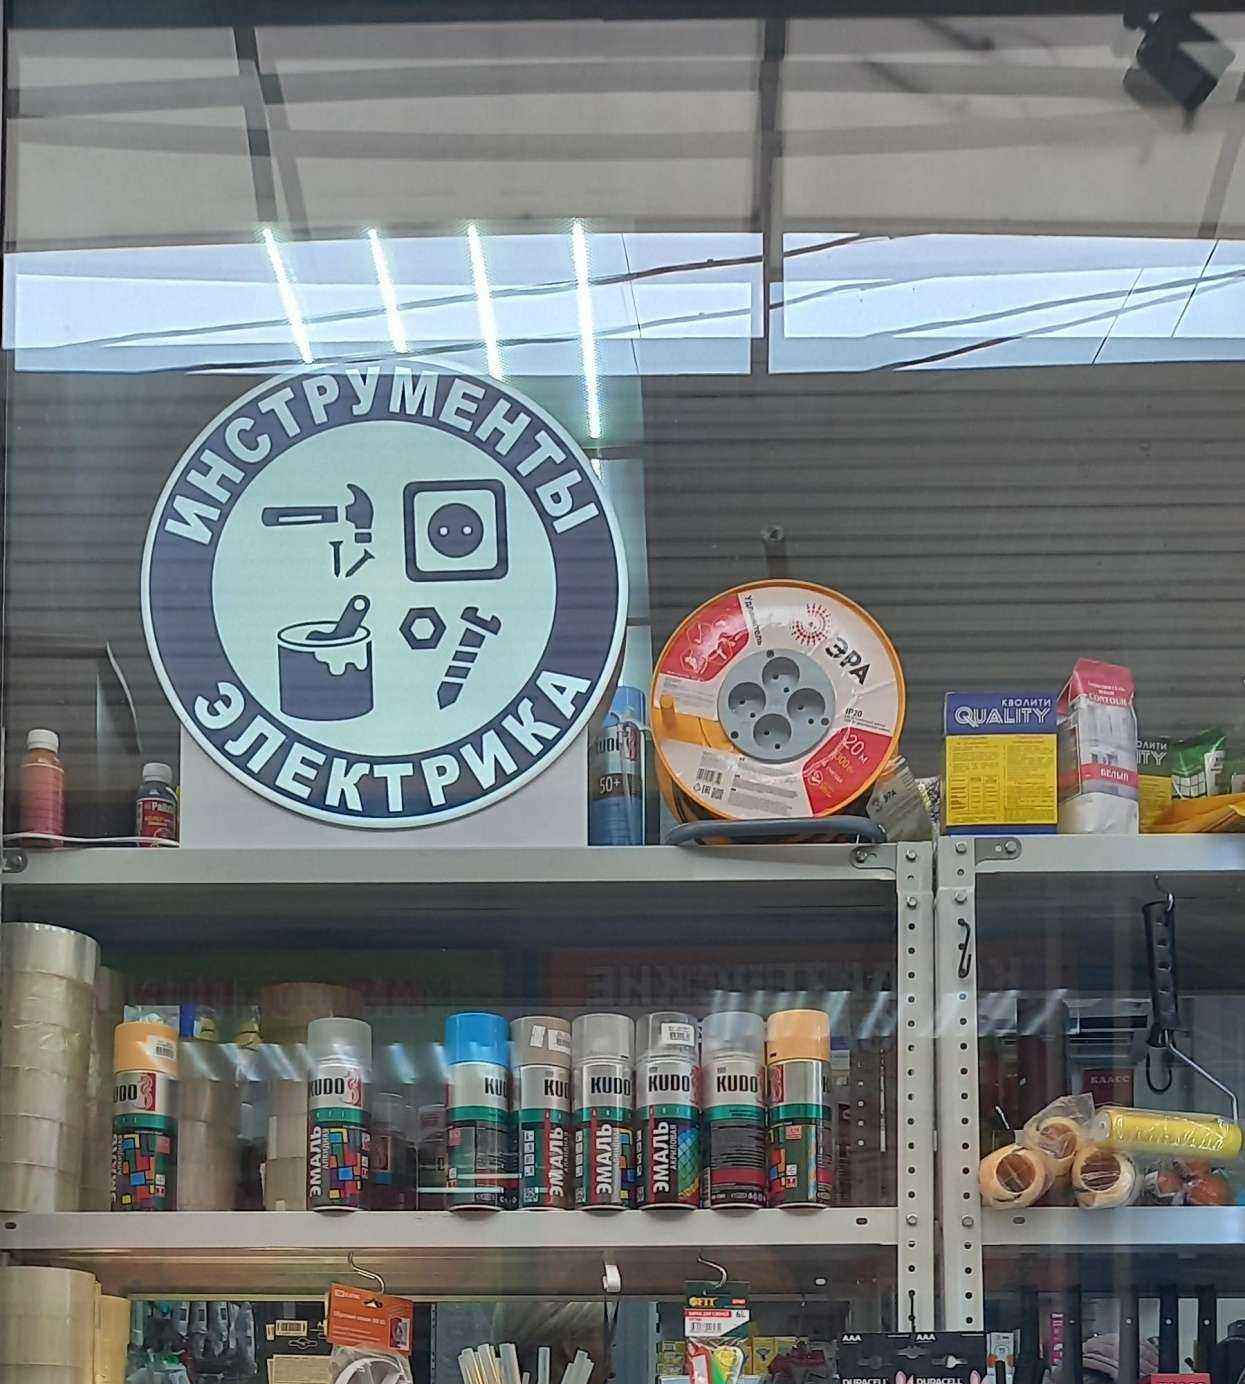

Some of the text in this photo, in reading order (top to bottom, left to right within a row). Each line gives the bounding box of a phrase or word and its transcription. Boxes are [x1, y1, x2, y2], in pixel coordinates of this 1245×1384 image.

[164, 366, 602, 547] ИНСТРУМЕНТЫ
[825, 636, 871, 686] ЭРА
[954, 706, 1051, 728] QUALITY
[1001, 698, 1052, 706] КВОЛИТИ
[194, 669, 591, 813] ЭЛЕКТРИКА
[599, 775, 621, 795] 50+
[590, 1076, 631, 1097] KUDO
[648, 1074, 691, 1092] KUDO
[716, 1074, 759, 1093] KUDO
[310, 1126, 322, 1199] ЭМАЛЬ
[549, 1126, 565, 1199] ЭМАЛЬ
[596, 1123, 613, 1196] ЭМАЛЬ
[652, 1121, 670, 1194] ЭМАЛЬ
